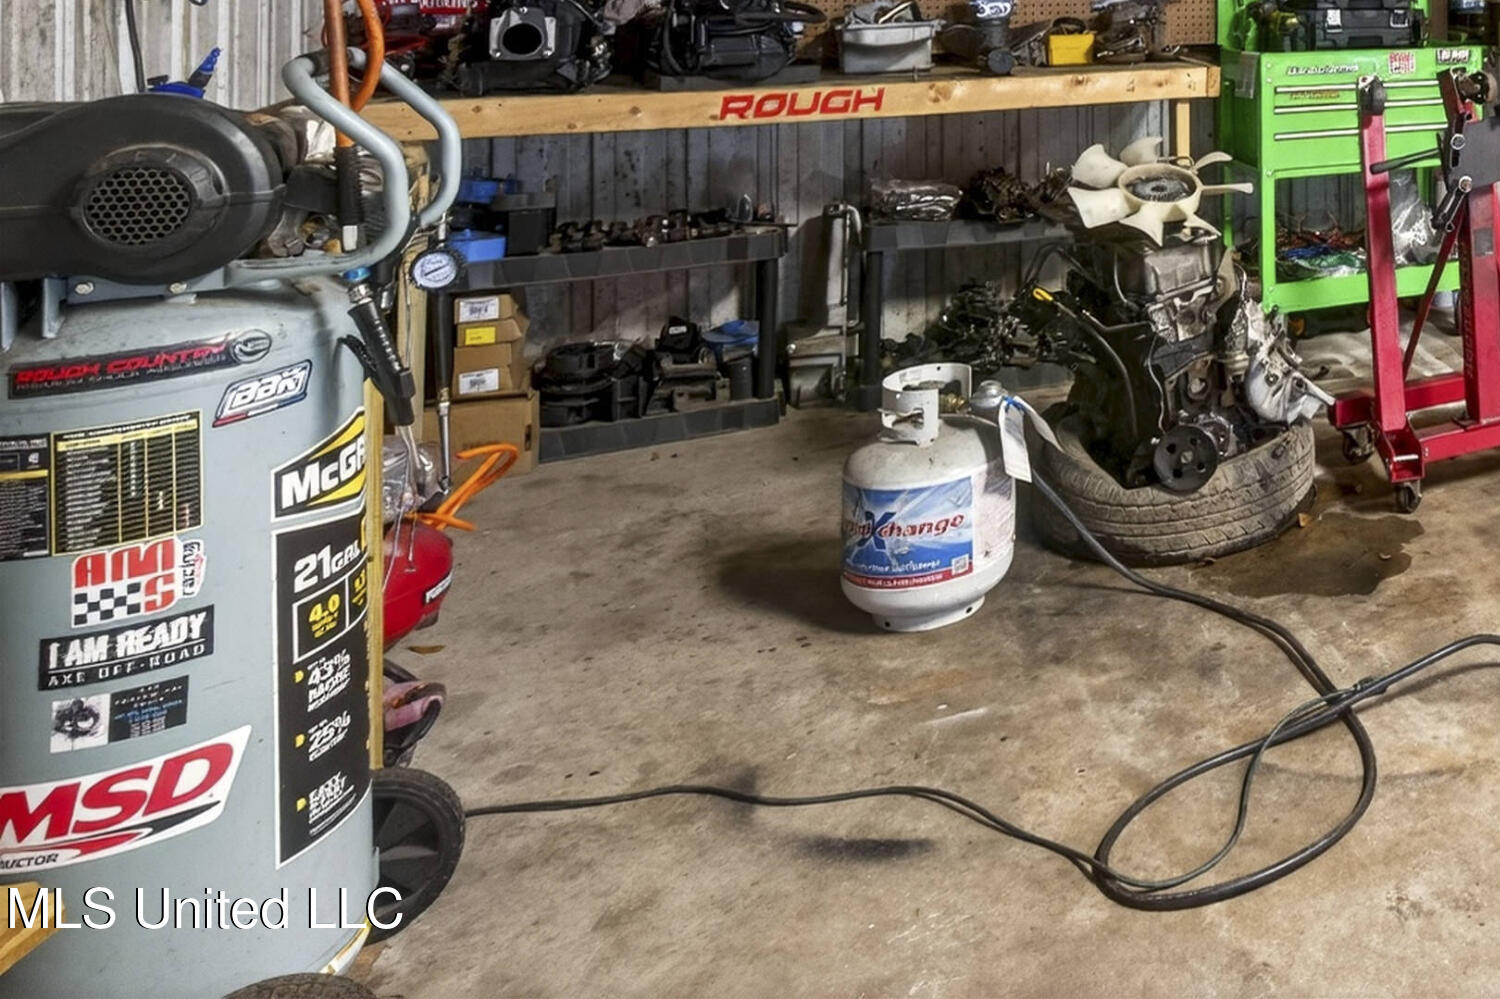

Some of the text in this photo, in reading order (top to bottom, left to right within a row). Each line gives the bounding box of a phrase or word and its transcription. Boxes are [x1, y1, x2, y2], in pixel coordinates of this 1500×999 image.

[719, 87, 885, 121] ROUGH
[15, 362, 100, 383] ROUGH
[308, 593, 341, 624] 4.0
[49, 611, 207, 669] I AM READY
[98, 645, 206, 679] OFF-ROAD
[308, 710, 351, 753] 25%
[0, 743, 234, 845] MSD
